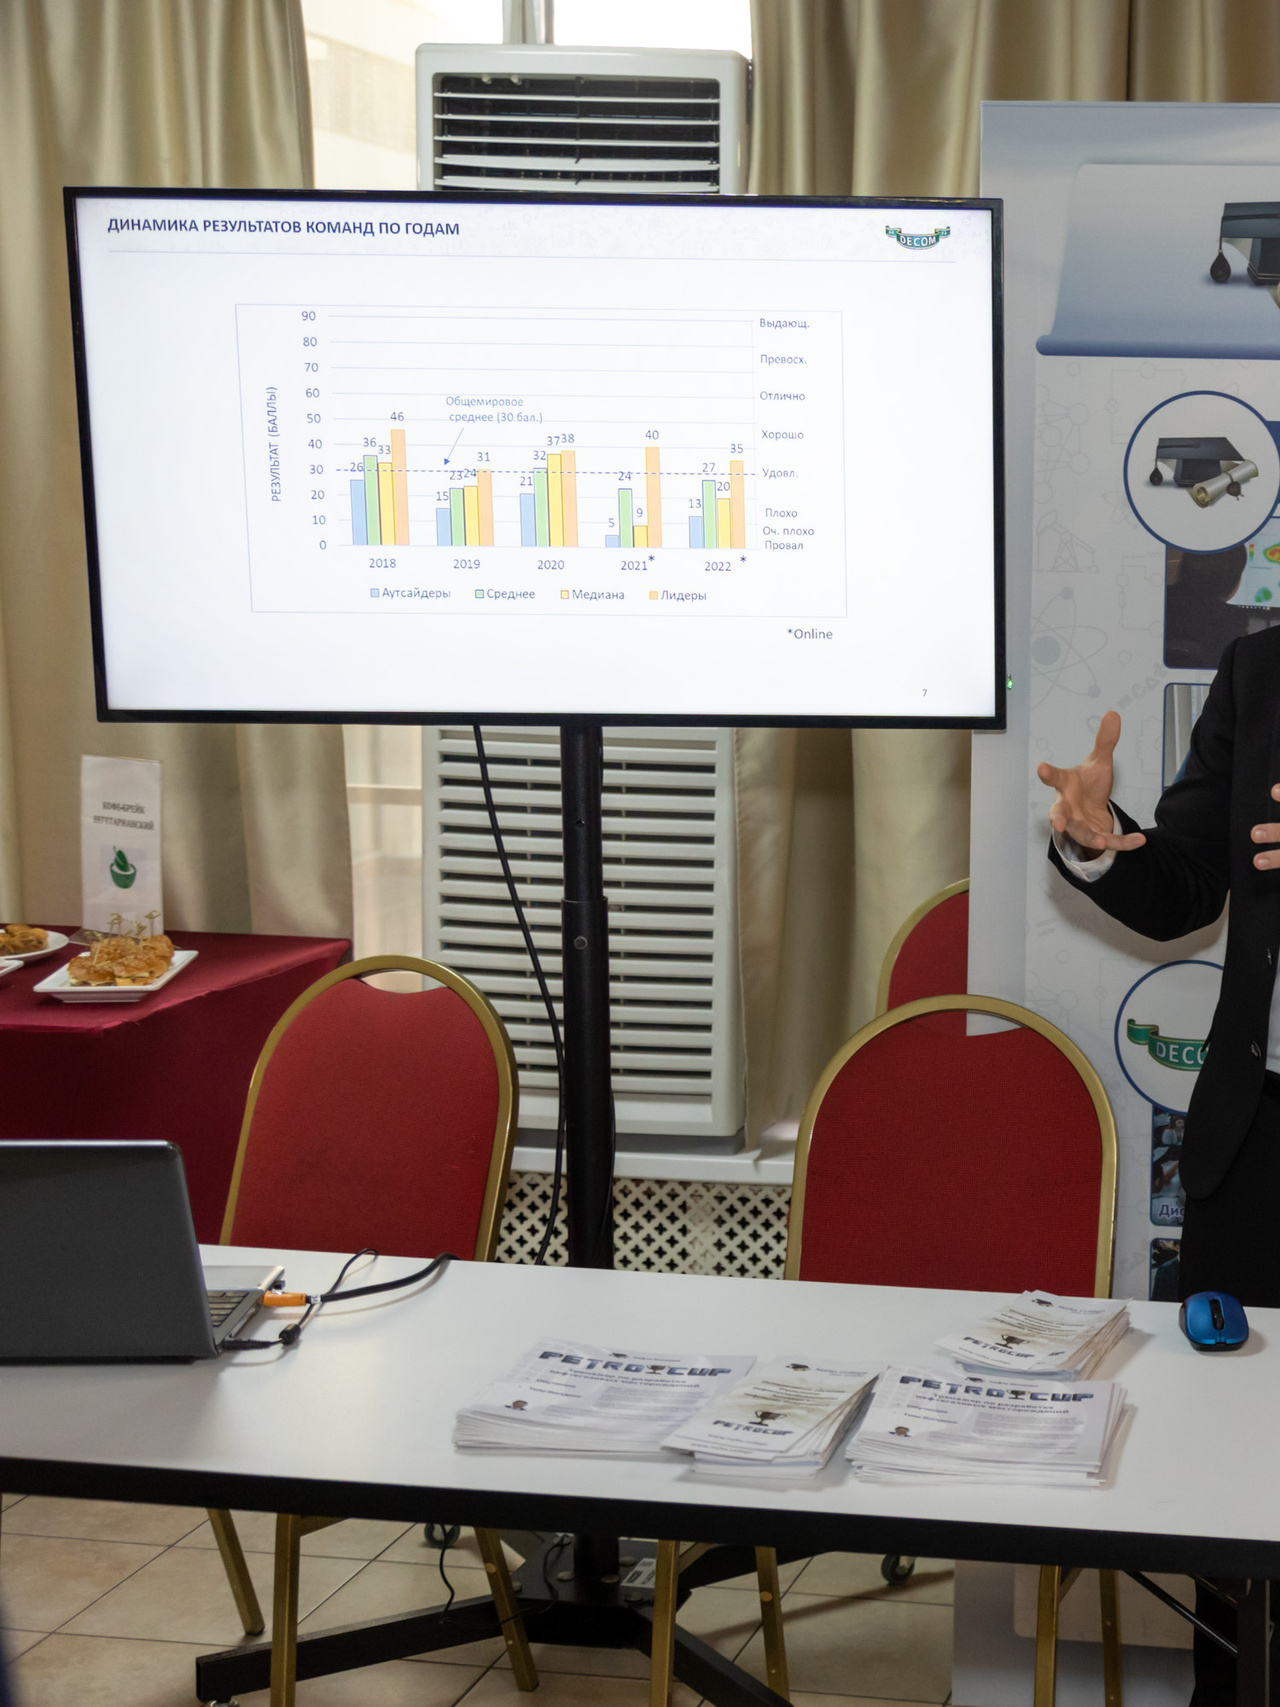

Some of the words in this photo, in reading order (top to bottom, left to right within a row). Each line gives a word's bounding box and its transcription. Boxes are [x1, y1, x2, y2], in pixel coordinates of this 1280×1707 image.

[107, 218, 199, 234] ДИНАМИКА
[203, 219, 302, 234] РЕЗУЛЬТАТОВ
[305, 220, 376, 237] КОМАНД
[379, 221, 401, 235] ПО
[405, 222, 460, 237] ГОДАМ
[900, 235, 937, 246] DECOM
[301, 310, 317, 322] 90
[759, 318, 810, 330] Выдающ.
[302, 336, 318, 348] 80
[760, 354, 807, 366] Превосх.
[304, 362, 319, 373] 70
[305, 387, 320, 399] 60
[759, 391, 805, 401] Отлично
[445, 396, 524, 408] Общемировое
[266, 387, 280, 437] (БАЛЛЫ)
[390, 412, 405, 422] 46
[449, 413, 494, 424] среднее
[496, 411, 514, 424] (30
[516, 411, 543, 424] бал.)
[306, 413, 321, 424] 50
[561, 434, 575, 444] 38
[645, 430, 659, 440] 40
[762, 430, 804, 441] Хорошо
[308, 438, 323, 450] 40
[363, 437, 377, 448] 36
[546, 436, 560, 446] 37
[377, 445, 391, 455] 33
[730, 444, 744, 454] 35
[477, 452, 490, 462] 31
[533, 450, 547, 460] 32
[269, 442, 281, 502] РЕЗУЛЬТАТ
[309, 464, 324, 475] 30
[350, 462, 364, 472] 26
[702, 463, 716, 473] 27
[449, 471, 463, 481] 23
[463, 468, 477, 478] 24
[618, 471, 632, 481] 24
[762, 468, 798, 480] Удовл.
[519, 476, 533, 486] 21
[717, 482, 730, 492] 20
[311, 490, 325, 500] 20
[436, 491, 449, 501] 15
[688, 499, 701, 509] 13
[765, 508, 798, 518] Плохо
[312, 515, 326, 525] 10
[762, 526, 780, 537] Оч.
[783, 528, 815, 537] плохо
[319, 540, 327, 550] 0
[765, 540, 804, 551] Провал
[369, 558, 397, 569] 2018
[453, 559, 481, 570] 2019
[537, 560, 565, 570] 2020
[382, 588, 451, 600] Аутсайдеры
[487, 589, 535, 600] Среднее
[572, 590, 624, 600] Медиана
[661, 591, 707, 602] Лидеры
[1156, 1041, 1209, 1064] DECO
